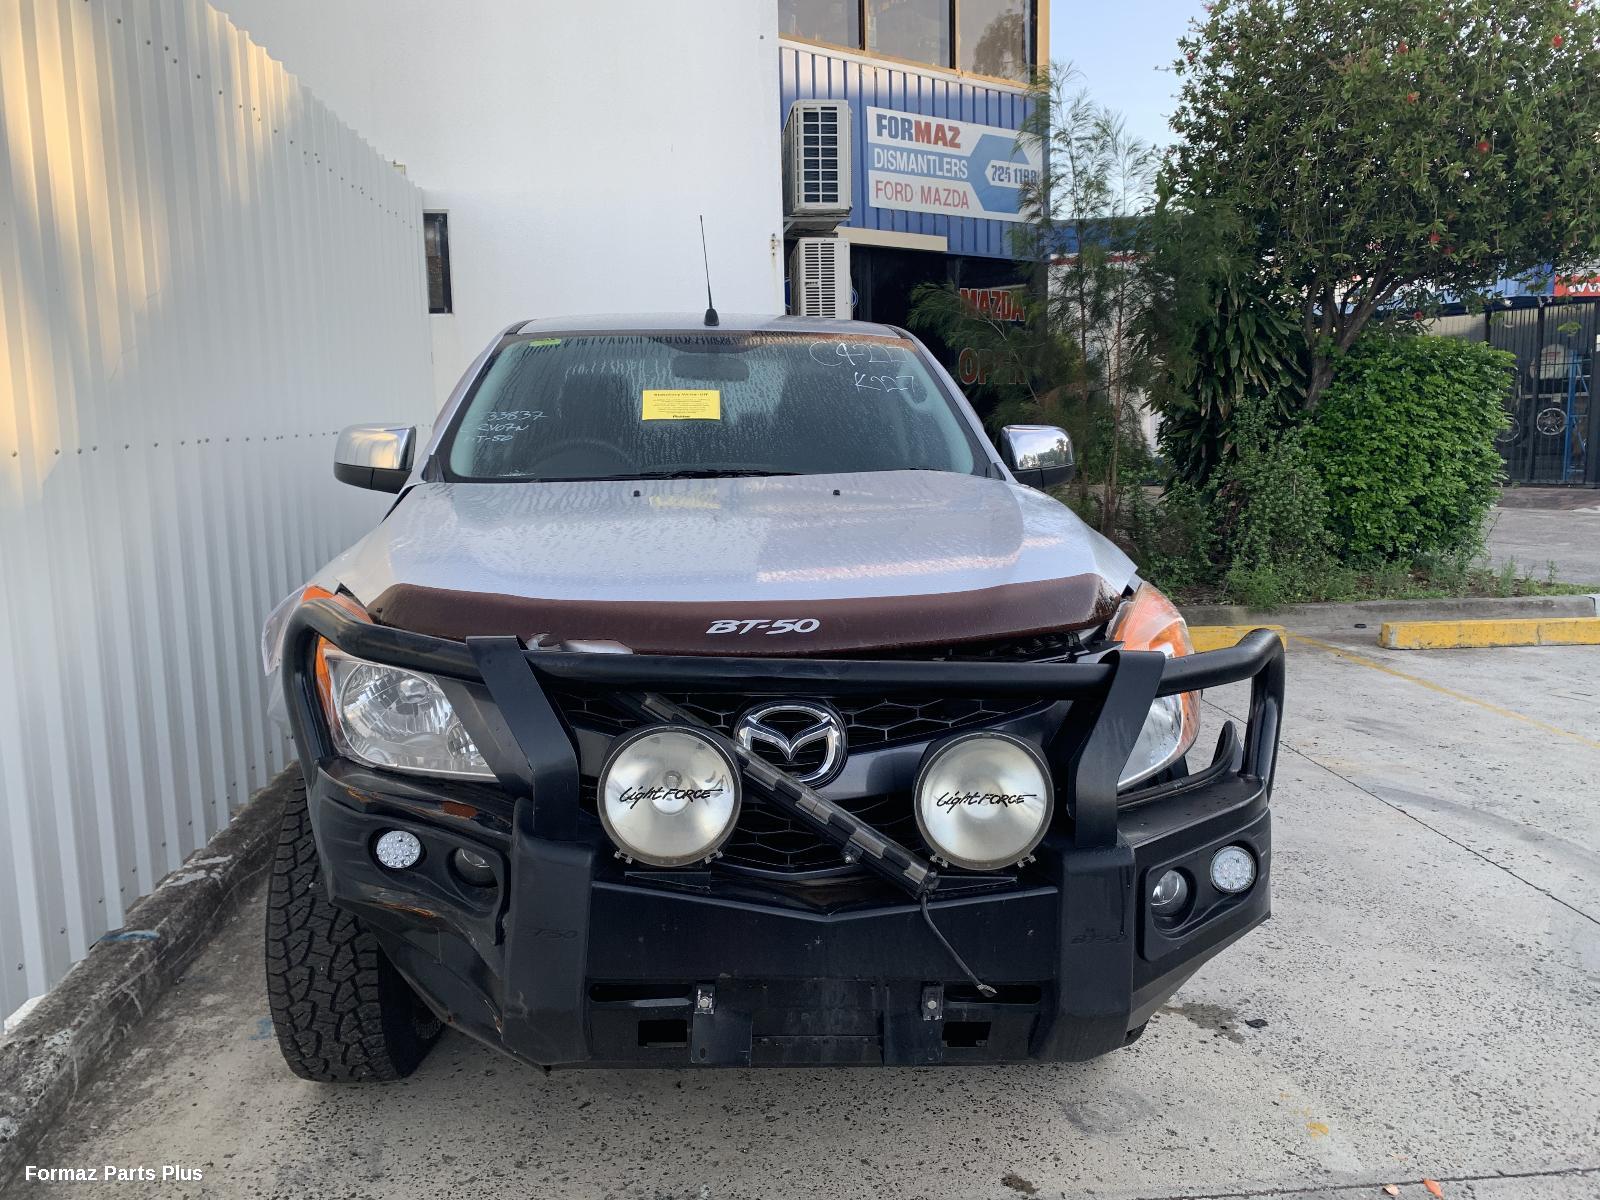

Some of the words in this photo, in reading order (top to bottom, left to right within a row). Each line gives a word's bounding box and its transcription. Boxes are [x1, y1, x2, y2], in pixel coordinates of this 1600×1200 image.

[876, 113, 961, 149] FORMAZ
[874, 148, 968, 178] DISMANTLERS
[875, 180, 914, 203] FORD
[920, 184, 970, 209] MAZDA
[959, 287, 1026, 322] MAZDA
[705, 618, 820, 635] BT-50
